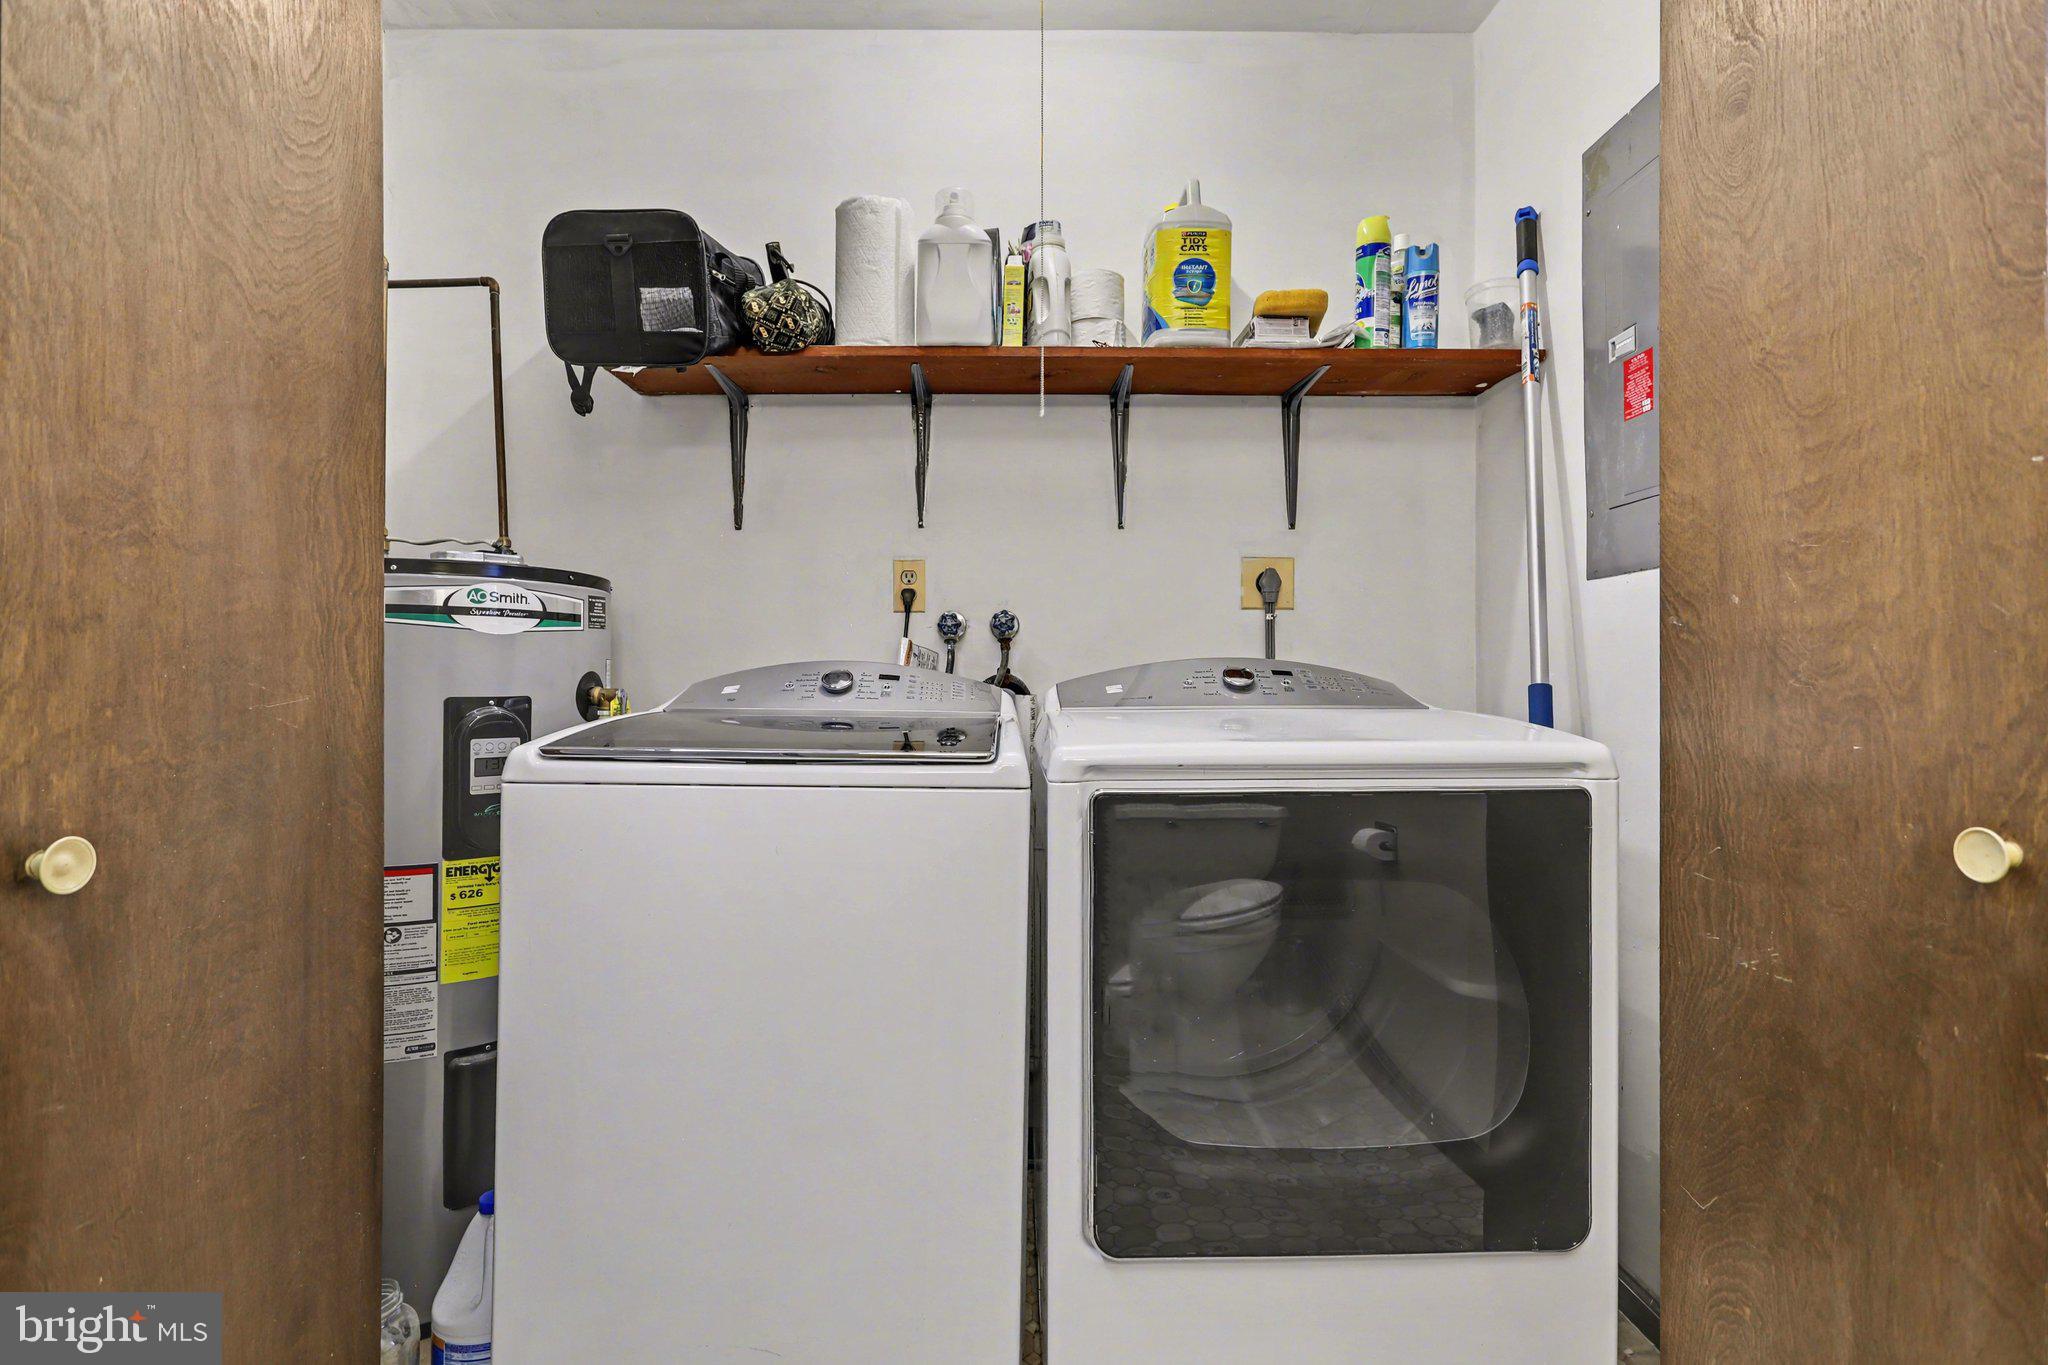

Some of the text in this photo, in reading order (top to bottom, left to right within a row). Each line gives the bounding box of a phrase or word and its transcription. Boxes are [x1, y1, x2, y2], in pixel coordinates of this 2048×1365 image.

[1180, 244, 1208, 252] CATS
[1405, 272, 1440, 301] Lysol
[459, 889, 483, 899] 626
